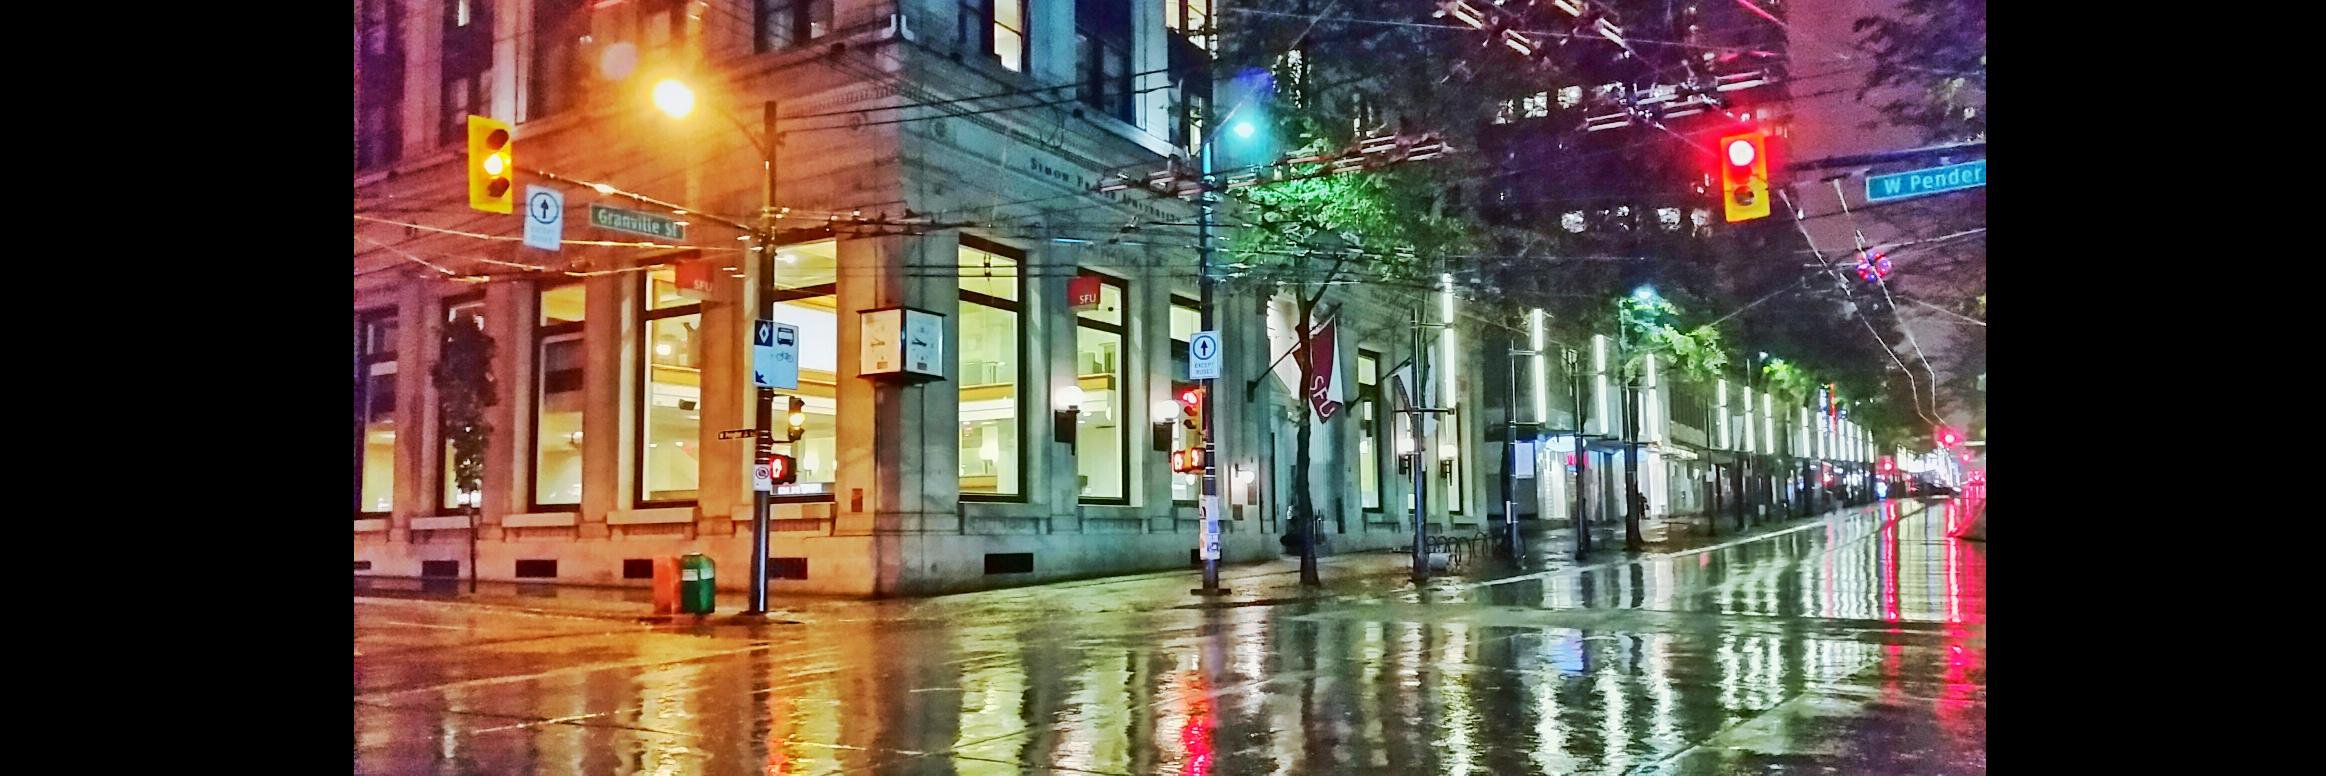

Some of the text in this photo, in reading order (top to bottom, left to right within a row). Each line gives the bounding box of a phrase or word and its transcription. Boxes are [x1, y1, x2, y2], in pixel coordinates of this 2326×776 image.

[1884, 168, 1982, 195] W Pender
[598, 208, 660, 234] Granville
[694, 279, 713, 292] SFU
[1079, 293, 1097, 305] SFU
[1310, 375, 1336, 418] SFU
